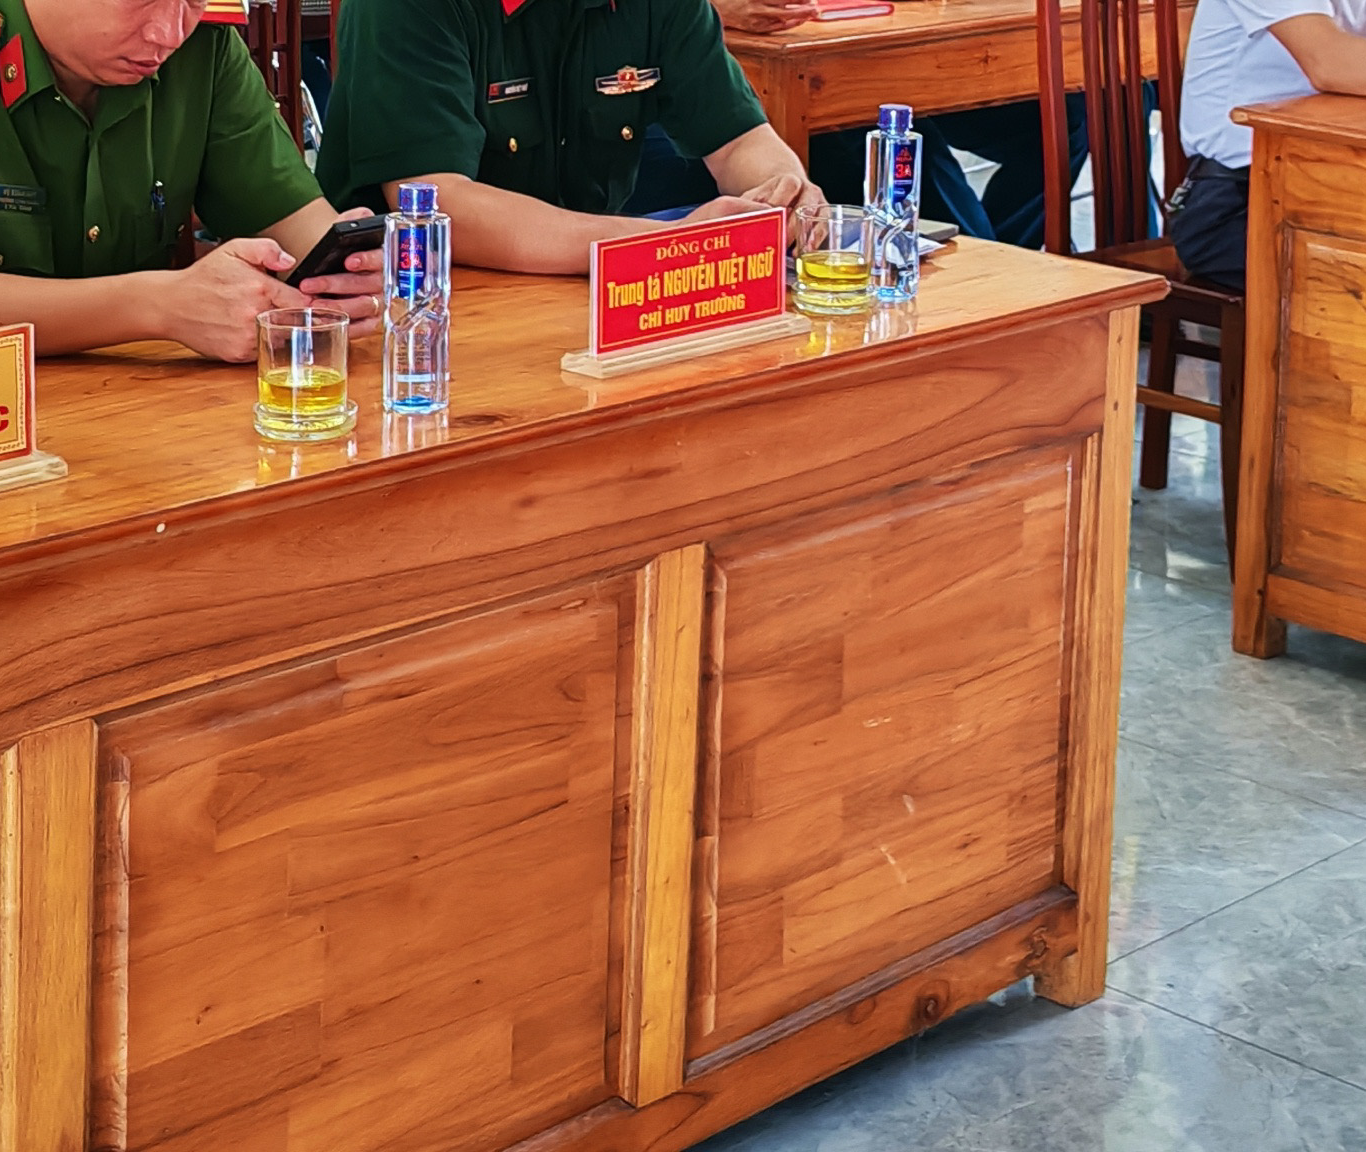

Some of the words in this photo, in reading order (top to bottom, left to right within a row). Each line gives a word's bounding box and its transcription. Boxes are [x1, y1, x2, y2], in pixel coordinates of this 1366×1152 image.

[655, 238, 700, 261] ĐỒNG
[702, 231, 731, 252] CHÍ
[607, 281, 645, 309] Trung
[647, 272, 661, 301] tá
[663, 254, 716, 298] NGUYỄN
[718, 252, 745, 290] VIỆT
[664, 304, 692, 325] HUY
